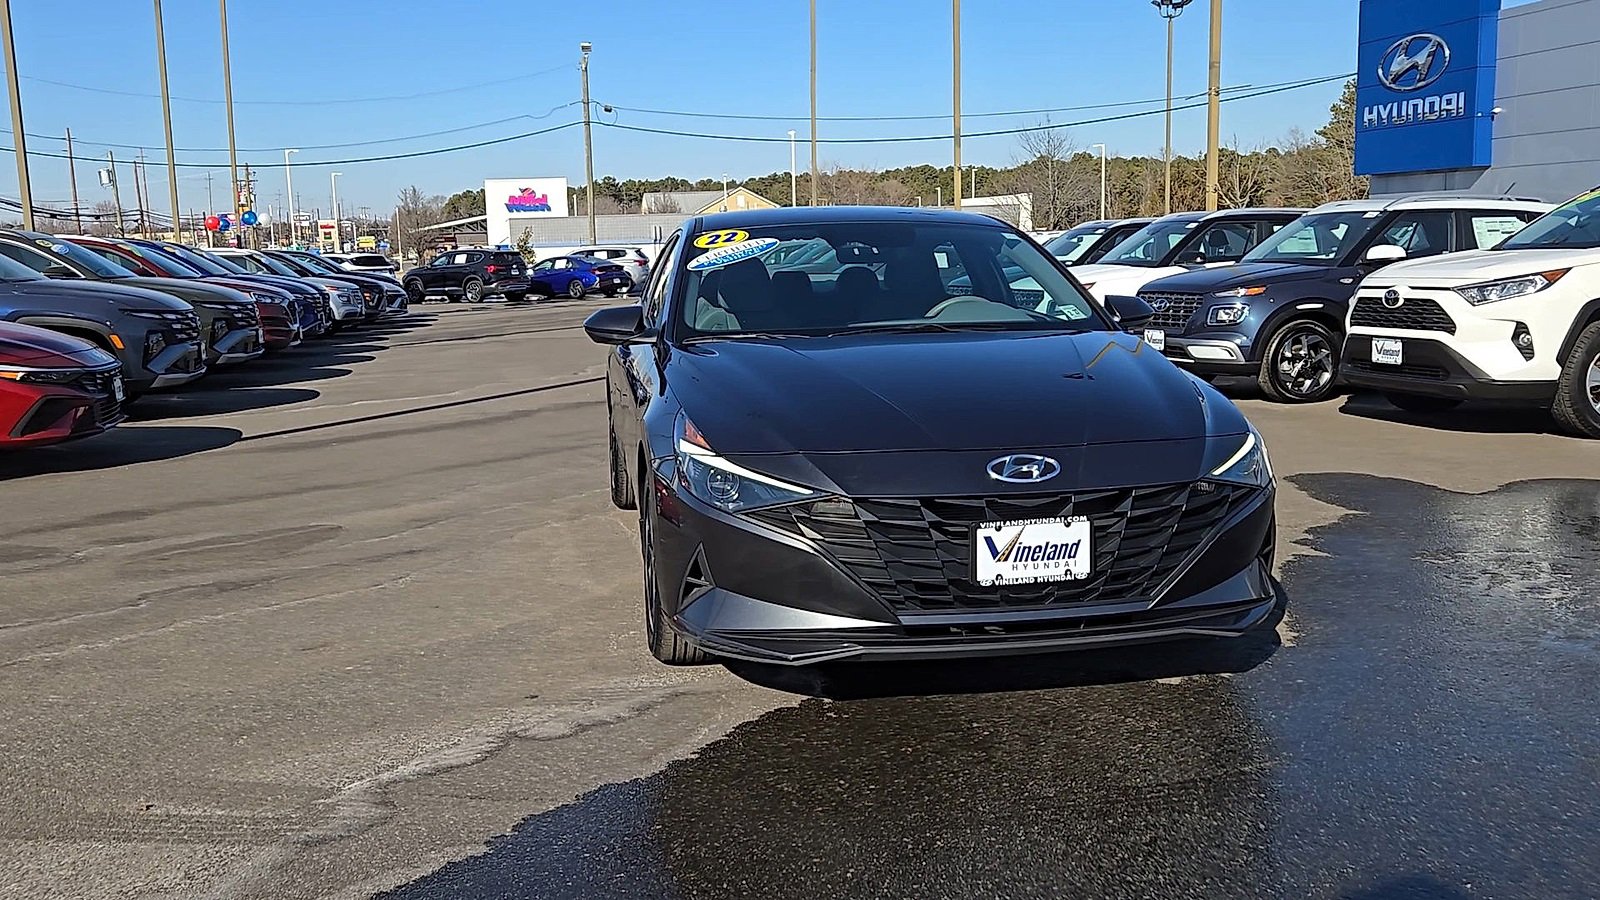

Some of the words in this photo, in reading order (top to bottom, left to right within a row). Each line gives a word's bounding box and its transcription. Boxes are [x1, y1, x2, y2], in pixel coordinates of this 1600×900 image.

[1363, 91, 1465, 128] HYUNDAI
[705, 232, 739, 245] 22
[695, 239, 766, 263] CERTIFIED
[979, 515, 1087, 529] VINELANDHYUNDAI.COM
[983, 525, 1082, 563] Vineland
[1012, 560, 1077, 571] HYUNDAI
[994, 576, 1035, 586] VINELAND
[1036, 573, 1075, 583] HYUNDAI
